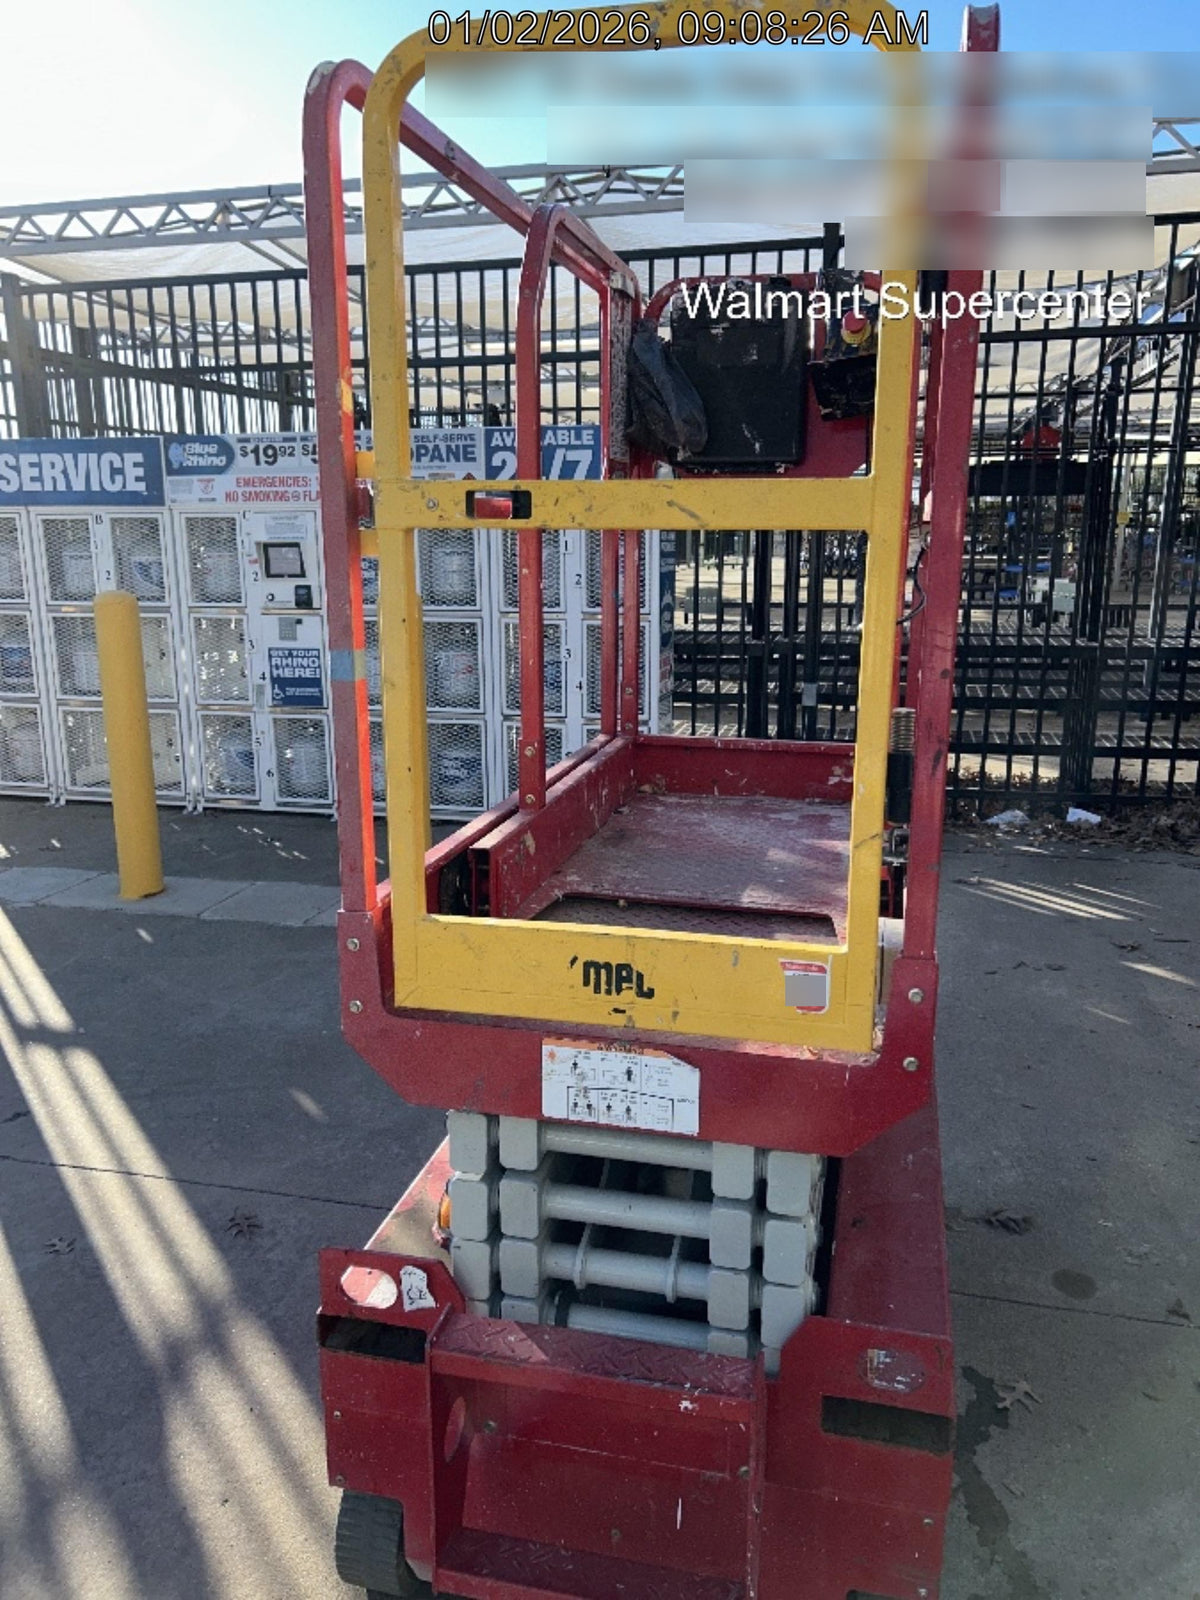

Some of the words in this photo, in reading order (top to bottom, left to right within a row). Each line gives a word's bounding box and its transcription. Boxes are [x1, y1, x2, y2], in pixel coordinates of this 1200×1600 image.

[413, 433, 476, 443] SELF-SERVE
[185, 442, 218, 454] Blue
[182, 455, 226, 467] Rhino
[0, 452, 147, 493] SERVICE
[225, 490, 239, 502] NO
[241, 490, 290, 502] SMOKING
[272, 657, 319, 667] RHINO
[272, 667, 321, 678] HERE!
